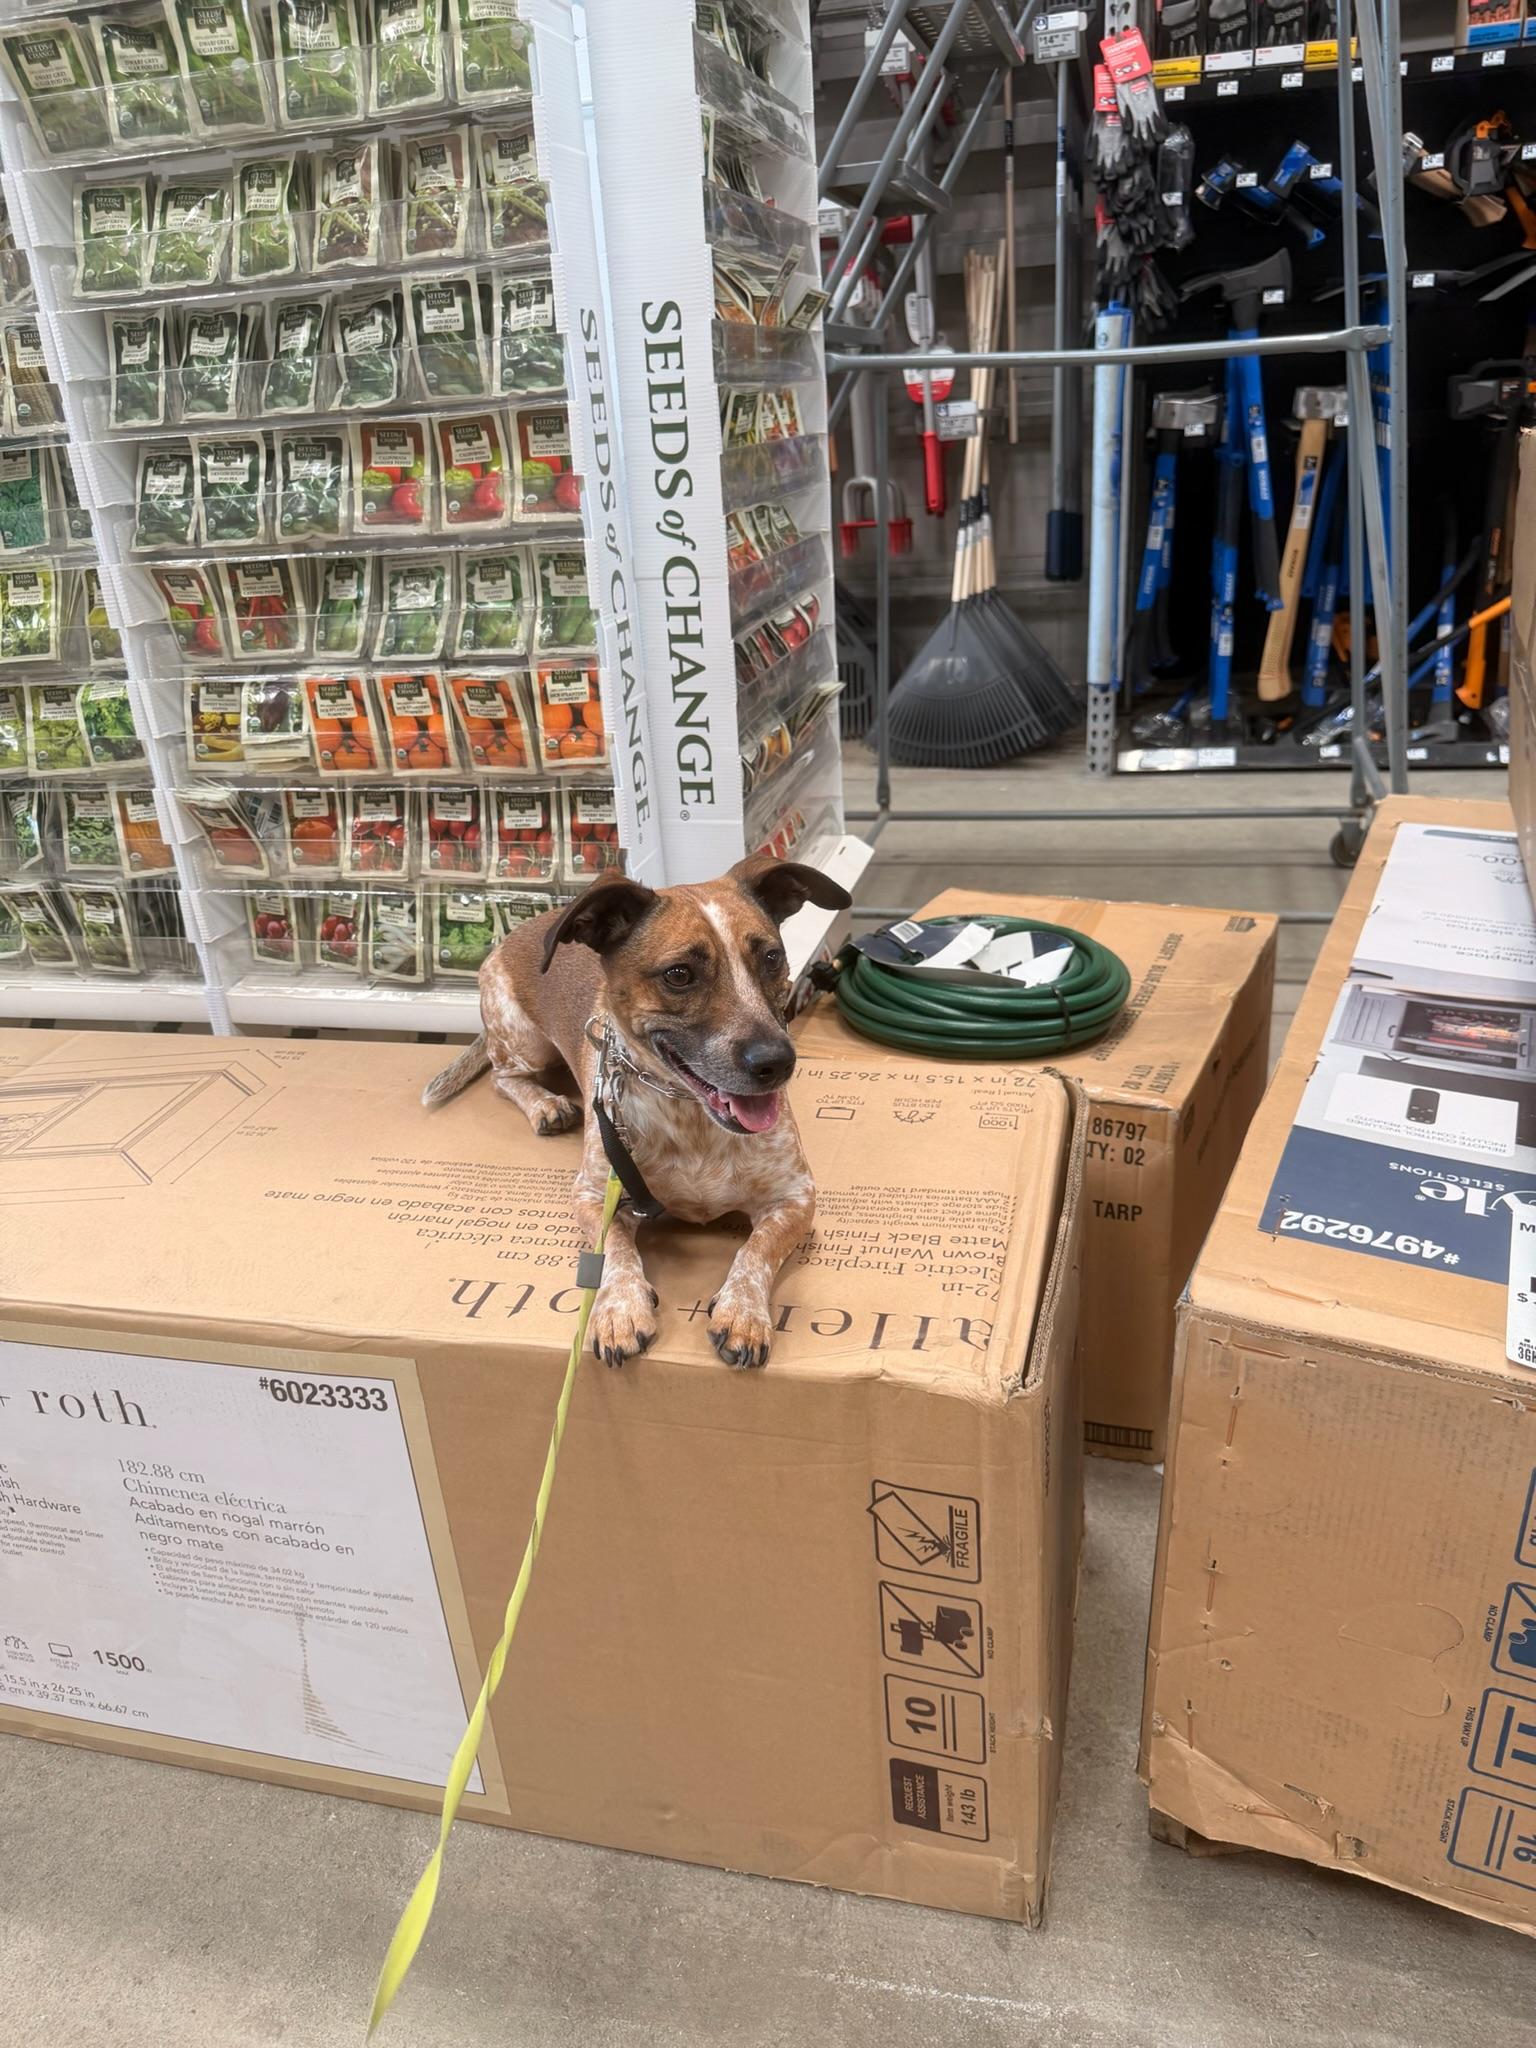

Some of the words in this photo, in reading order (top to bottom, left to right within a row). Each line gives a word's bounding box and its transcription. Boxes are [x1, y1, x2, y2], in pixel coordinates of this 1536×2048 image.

[641, 300, 694, 499] SEEDS
[580, 309, 616, 513] SEEDS
[606, 522, 622, 563] of
[656, 510, 696, 551] of
[808, 1070, 823, 1079] in
[830, 1070, 881, 1082] 26.25
[887, 1072, 898, 1080] x
[903, 1073, 920, 1084] in
[926, 1074, 964, 1084] 15.5
[990, 1076, 1006, 1086] in
[1014, 1077, 1037, 1088] 72
[983, 1119, 1013, 1128] 1000
[1123, 1147, 1145, 1166] 02
[1388, 1161, 1505, 1192] SELECTIONS
[264, 1190, 309, 1202] mate
[877, 1193, 922, 1201] included
[910, 1187, 956, 1195] standard
[925, 1194, 972, 1202] batteries
[975, 1194, 1000, 1204] AAA
[313, 1193, 365, 1206] negro
[370, 1198, 392, 1208] en
[398, 1199, 474, 1215] acabado
[851, 1203, 902, 1212] operated
[896, 1200, 939, 1208] cabinets
[942, 1200, 979, 1210] storage
[480, 1206, 512, 1217] con
[941, 1209, 972, 1218] effect
[1092, 1200, 1142, 1222] TARP
[387, 1212, 453, 1227] marrón
[456, 1217, 510, 1229] nogal
[516, 1222, 539, 1232] en
[836, 1217, 878, 1226] capacity
[882, 1218, 918, 1227] weight
[921, 1221, 974, 1231] maximum
[416, 1227, 503, 1250] eléctrica
[824, 1229, 880, 1242] Finish
[887, 1232, 940, 1246] Black
[950, 1235, 1008, 1252] Matte
[1280, 1210, 1460, 1267] #4976292
[496, 1250, 530, 1262] cm
[796, 1242, 852, 1256] Finish
[859, 1245, 934, 1260] Walnut
[796, 1256, 905, 1276] Fireplace
[448, 1278, 582, 1320] oth.
[941, 1282, 1000, 1303] 72-in
[259, 1376, 388, 1412] #6023333
[117, 1458, 174, 1480] 182.88
[179, 1470, 205, 1484] cm
[13, 1494, 81, 1514] Hardware
[122, 1477, 209, 1504] Chimenea
[214, 1484, 287, 1515] eléctrica
[129, 1496, 194, 1518] Acabado
[199, 1508, 218, 1520] en
[222, 1510, 265, 1529] nogal
[270, 1516, 325, 1536] marrón
[134, 1512, 229, 1538] Aditamentos
[232, 1529, 260, 1542] con
[264, 1532, 330, 1553] acabado
[335, 1543, 355, 1556] en
[140, 1530, 182, 1546] negro
[187, 1537, 224, 1552] mate
[953, 1508, 970, 1569] FRAGILE
[1487, 1604, 1499, 1616] NO
[1482, 1616, 1496, 1642] CLAMP
[986, 1626, 994, 1649] CLAMP
[92, 1649, 145, 1672] 1500
[987, 1650, 994, 1660] NO
[4, 1674, 27, 1686] 15.5
[29, 1679, 39, 1688] in
[51, 1682, 82, 1697] 26.25
[84, 1689, 95, 1699] in
[9, 1687, 25, 1696] cm
[36, 1689, 65, 1703] 39.37
[69, 1697, 86, 1707] cm
[98, 1702, 128, 1714] 66.67
[132, 1710, 149, 1718] cm
[904, 1696, 938, 1734] 10
[1464, 1706, 1476, 1722] THIS
[1461, 1722, 1473, 1738] WAY
[1459, 1738, 1470, 1748] UP
[902, 1775, 915, 1812] REQUEST
[915, 1775, 927, 1820] ASSISTANCE
[944, 1784, 954, 1806] weight
[960, 1788, 976, 1801] lb
[945, 1807, 954, 1823] Item
[960, 1803, 976, 1826] 143
[1443, 1798, 1456, 1820] STACK
[1439, 1820, 1451, 1845] HEIGHT
